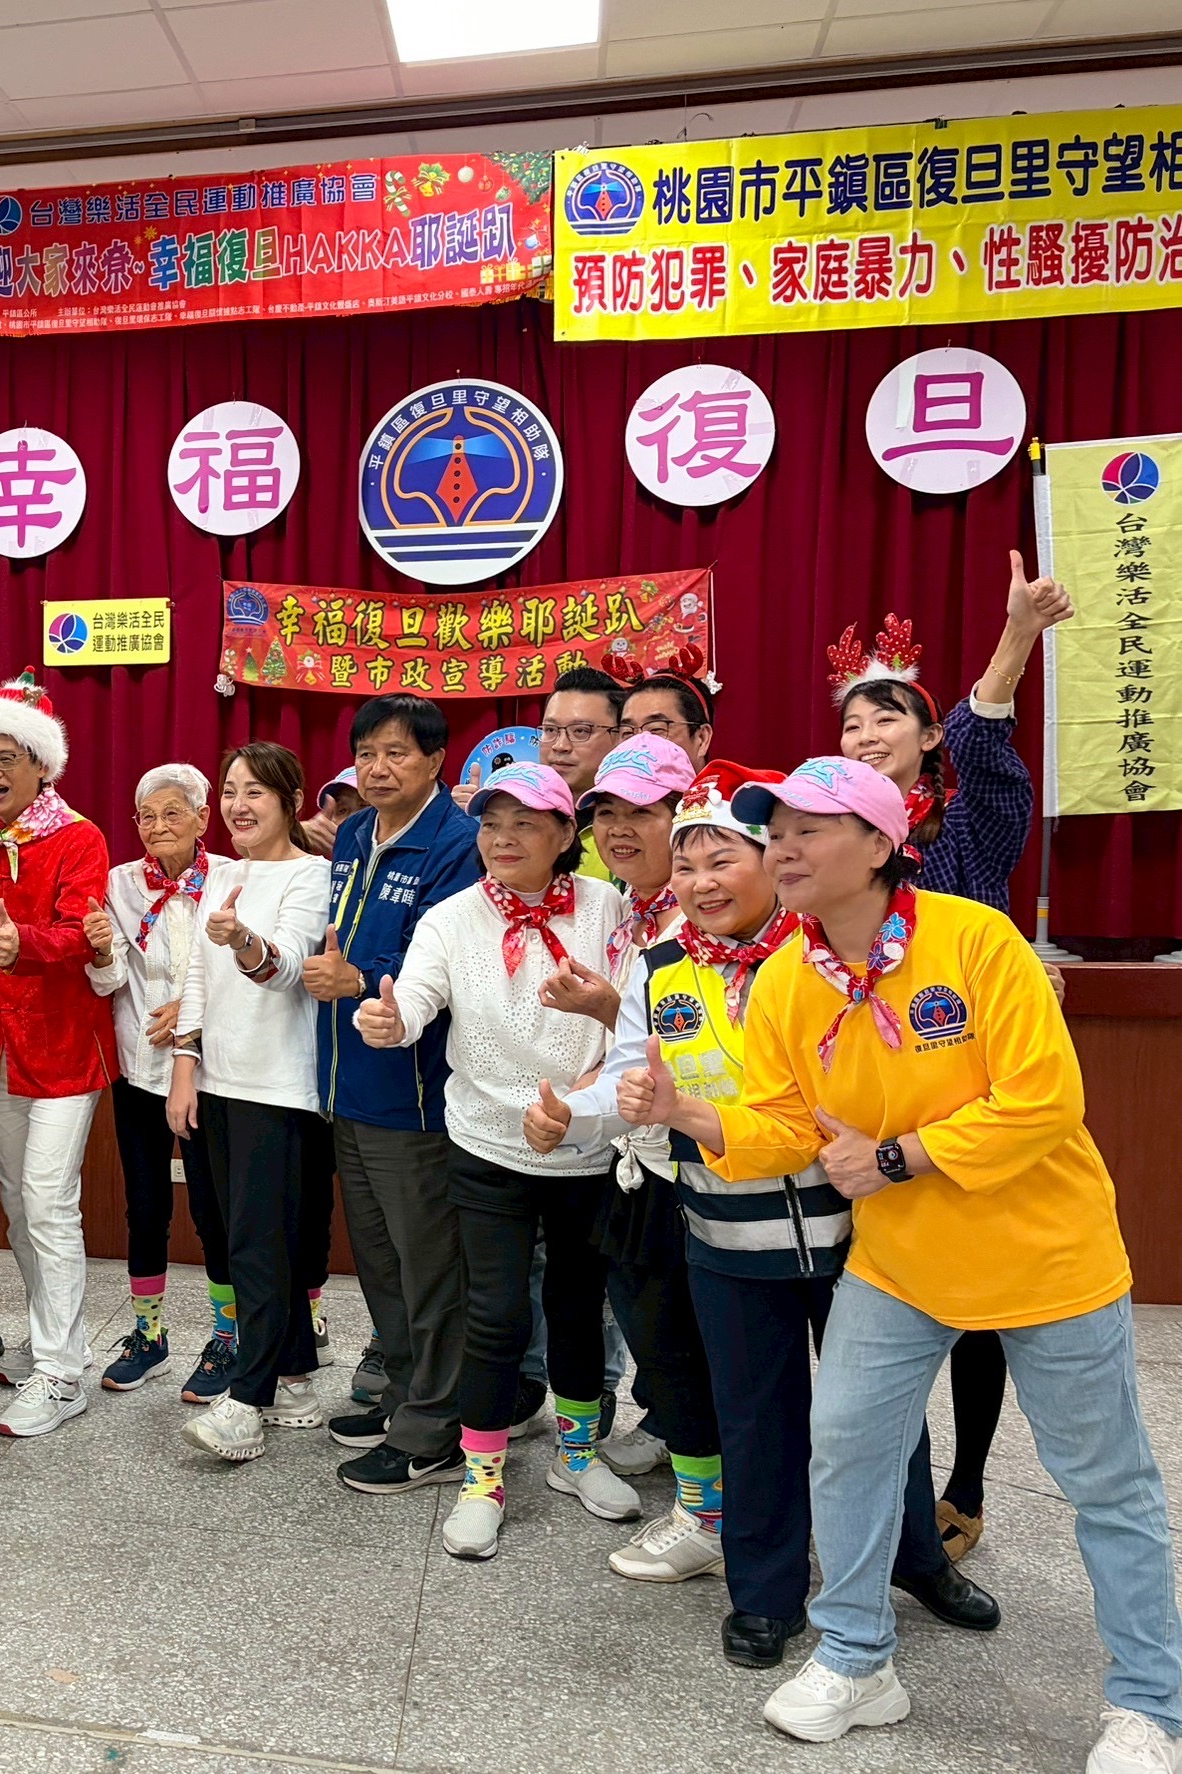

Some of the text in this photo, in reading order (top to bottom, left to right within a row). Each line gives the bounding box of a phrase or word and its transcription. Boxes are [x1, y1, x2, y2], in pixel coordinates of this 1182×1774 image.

[30, 172, 377, 228] 台灣樂活全民運動推廣協會
[652, 131, 1182, 226] 桃園市平鎮區復旦里守望相
[572, 213, 1182, 316] 預防犯罪、家庭暴力、性騷擾防治
[173, 425, 284, 514] 福
[636, 389, 762, 484] 復
[881, 371, 1014, 461] 旦
[368, 389, 550, 470] 平鎮區復旦里守望相助隊
[92, 610, 165, 630] 台灣樂活全民
[92, 632, 165, 653] 運動推廣協會
[275, 591, 645, 652] 幸福復旦歡樂耶誕趴
[330, 649, 587, 692] 暨市政宣導活動
[1114, 513, 1156, 802] 台灣樂活全民運動推廣協會
[481, 732, 516, 757] 防詐騙
